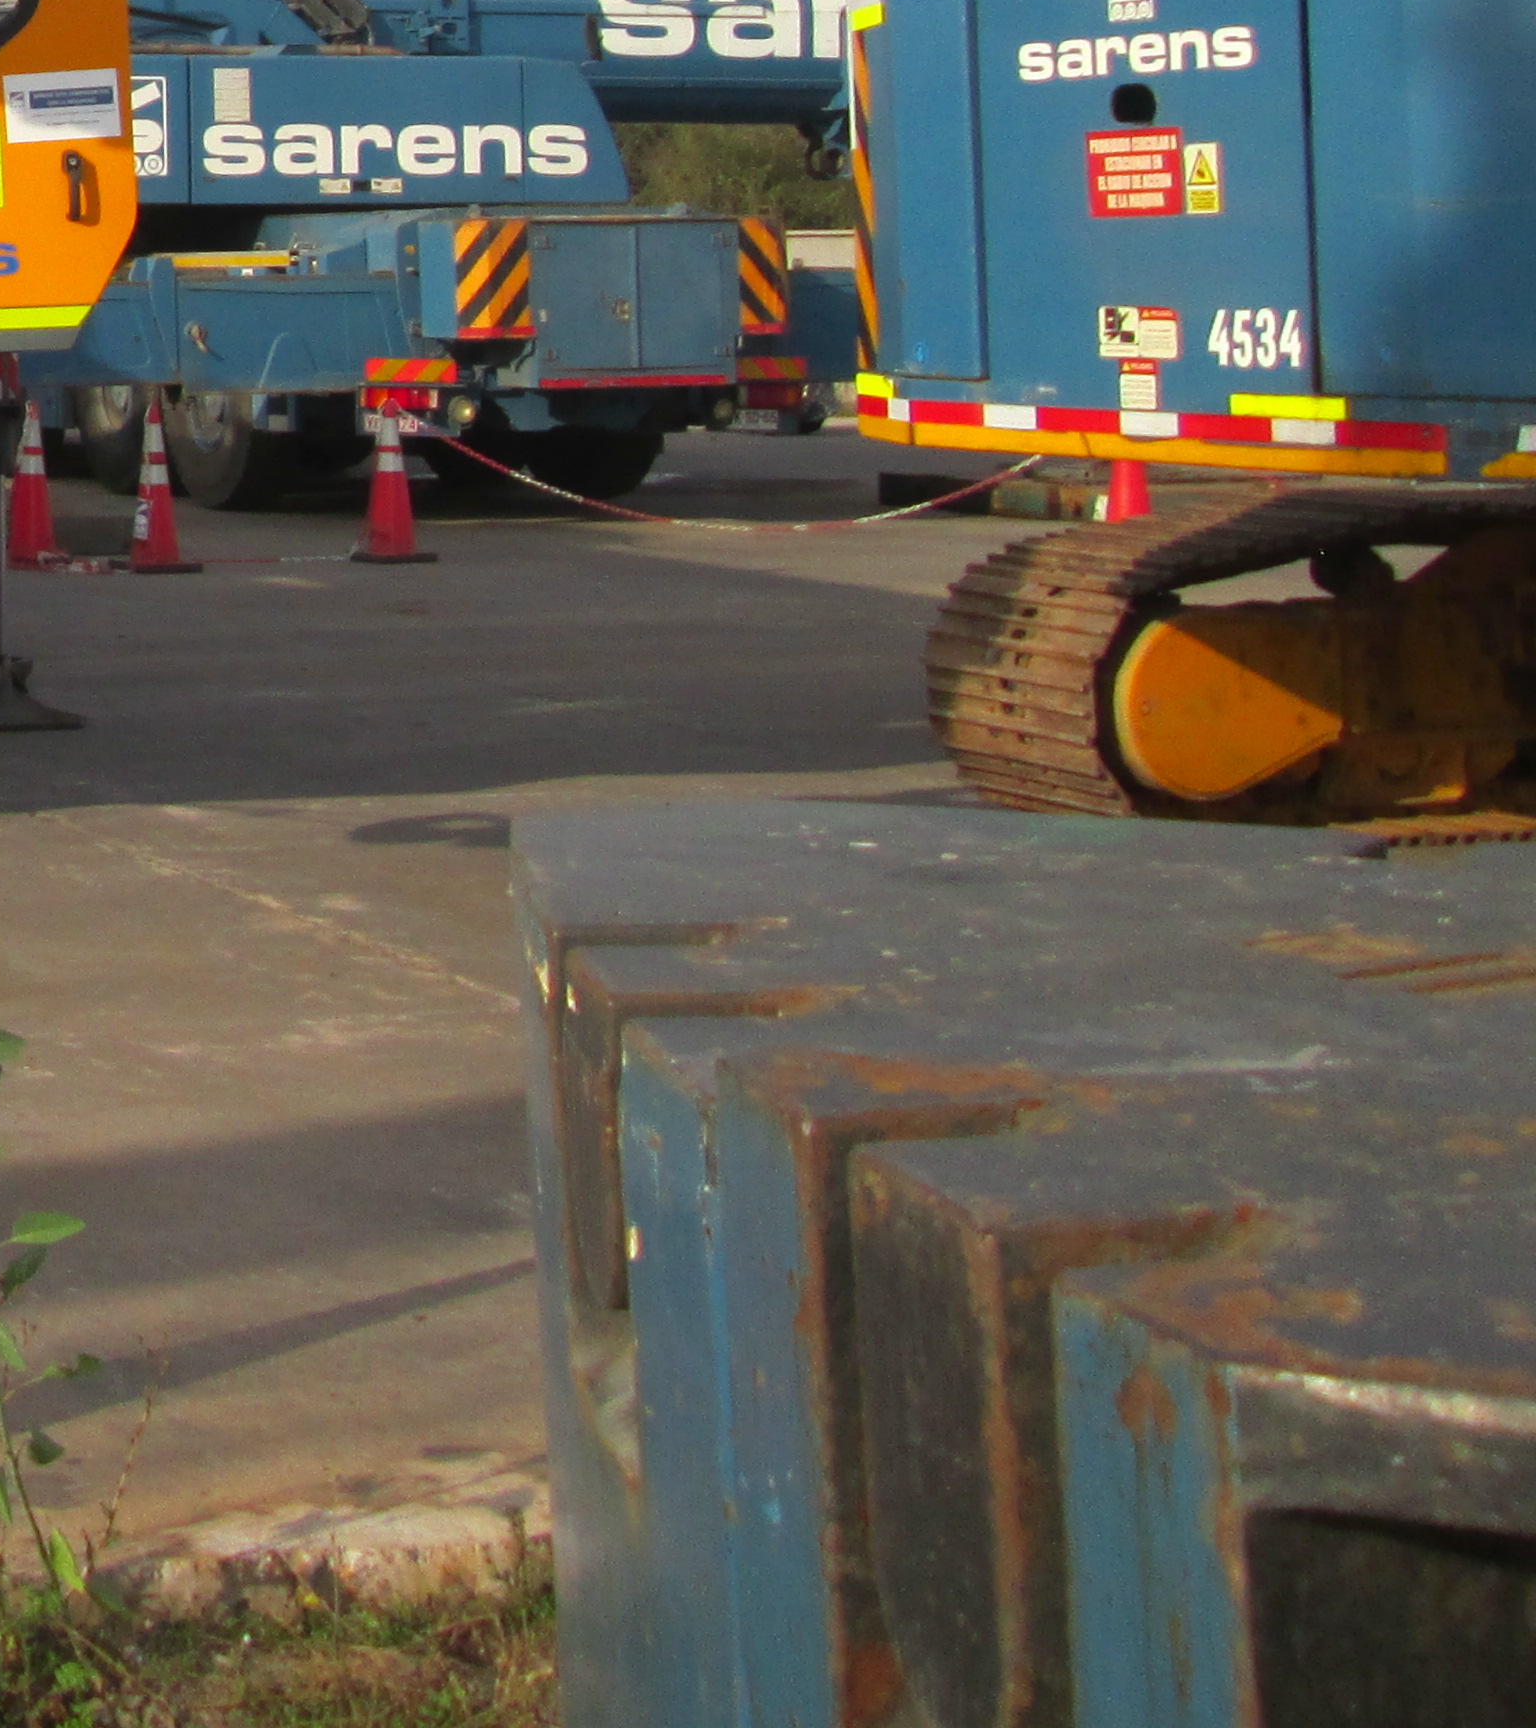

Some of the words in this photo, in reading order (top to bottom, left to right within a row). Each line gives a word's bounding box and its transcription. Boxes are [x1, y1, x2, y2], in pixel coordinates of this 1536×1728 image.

[1018, 24, 1254, 82] sarens
[202, 122, 589, 177] sarens
[1207, 307, 1302, 368] 4534
